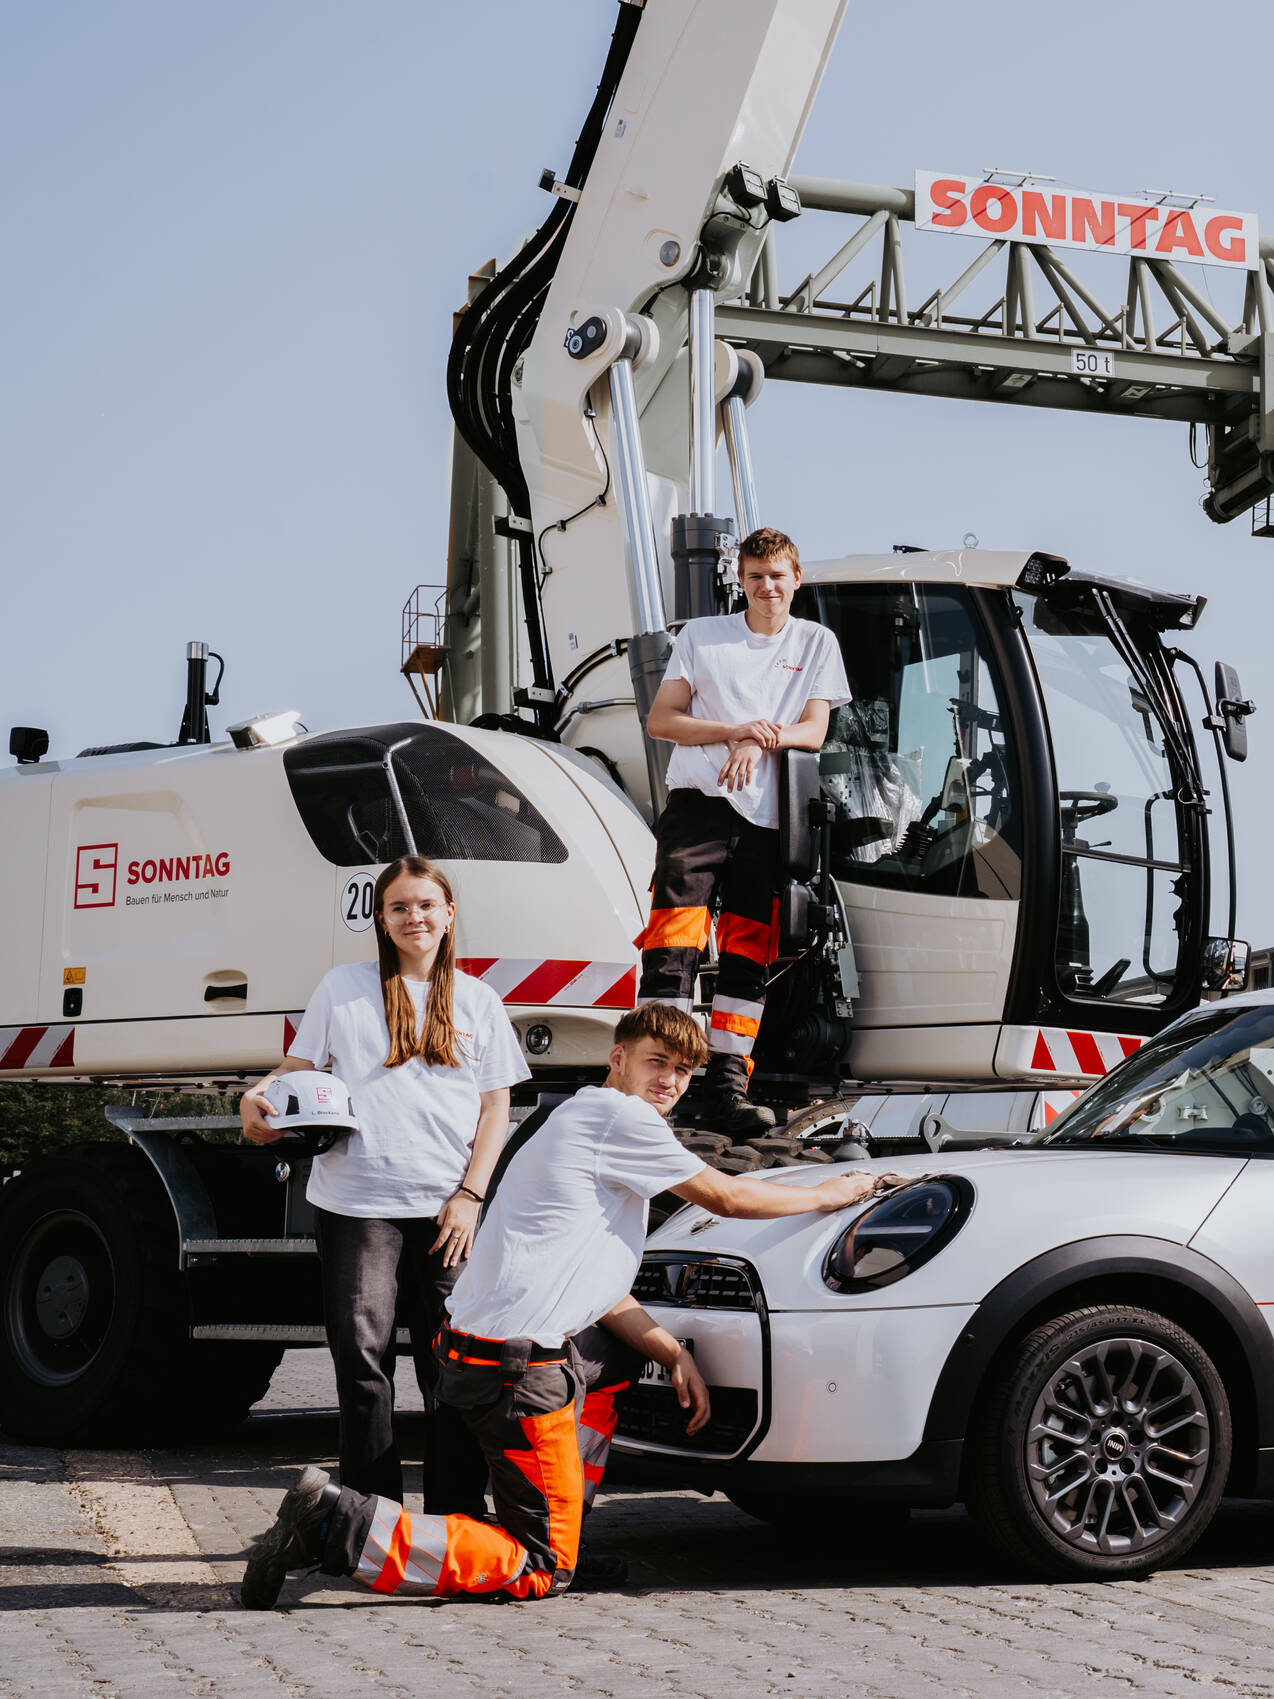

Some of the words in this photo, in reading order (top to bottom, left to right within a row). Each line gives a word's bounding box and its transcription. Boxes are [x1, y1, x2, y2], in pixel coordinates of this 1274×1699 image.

[930, 179, 1246, 262] SONNTAG
[1076, 353, 1098, 372] 50
[1104, 357, 1110, 373] t
[127, 852, 230, 885] SONNTAG
[125, 896, 150, 906] Bauen
[151, 894, 162, 904] für
[163, 891, 193, 903] Mensch
[194, 890, 209, 900] und
[210, 889, 229, 899] Natur
[346, 881, 374, 920] 20
[1107, 1439, 1124, 1453] MINI
